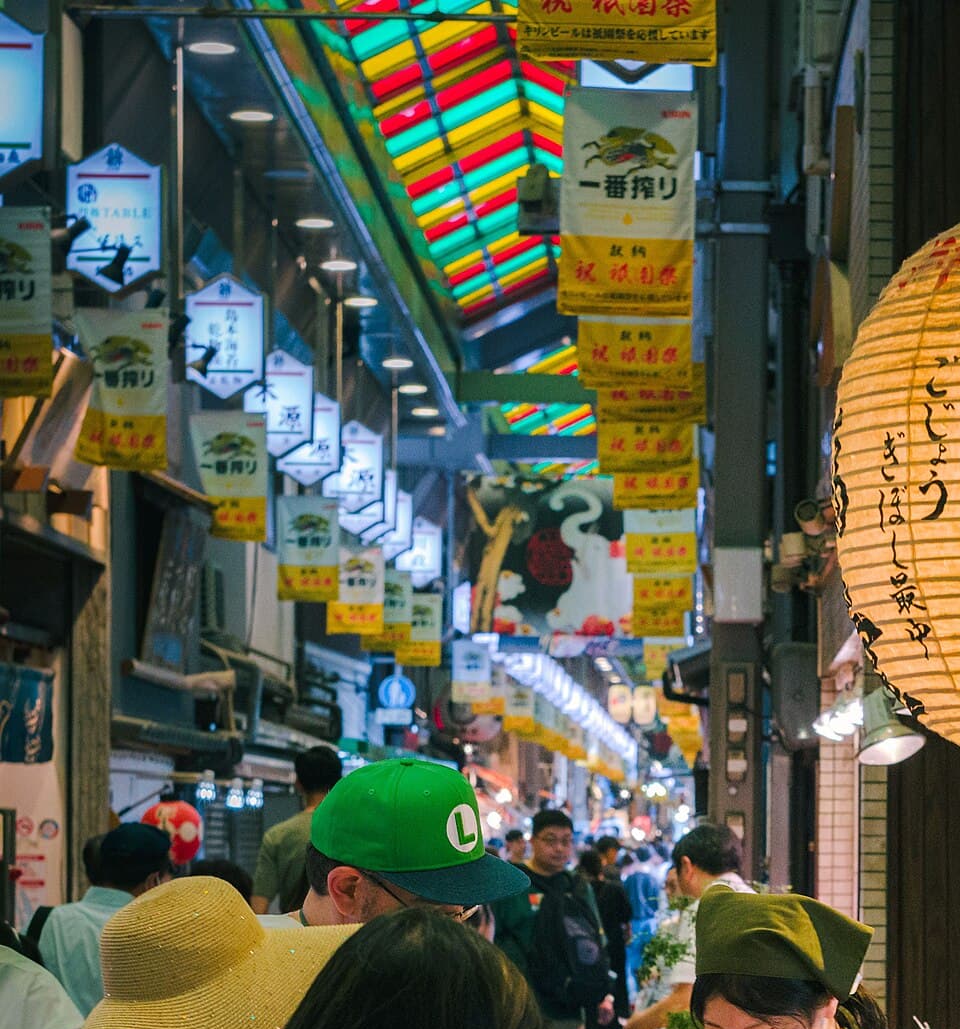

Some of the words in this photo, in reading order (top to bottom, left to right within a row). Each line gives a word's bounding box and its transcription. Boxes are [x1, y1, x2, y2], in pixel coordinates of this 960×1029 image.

[579, 175, 677, 200] 一番搾り
[456, 813, 475, 846] L
